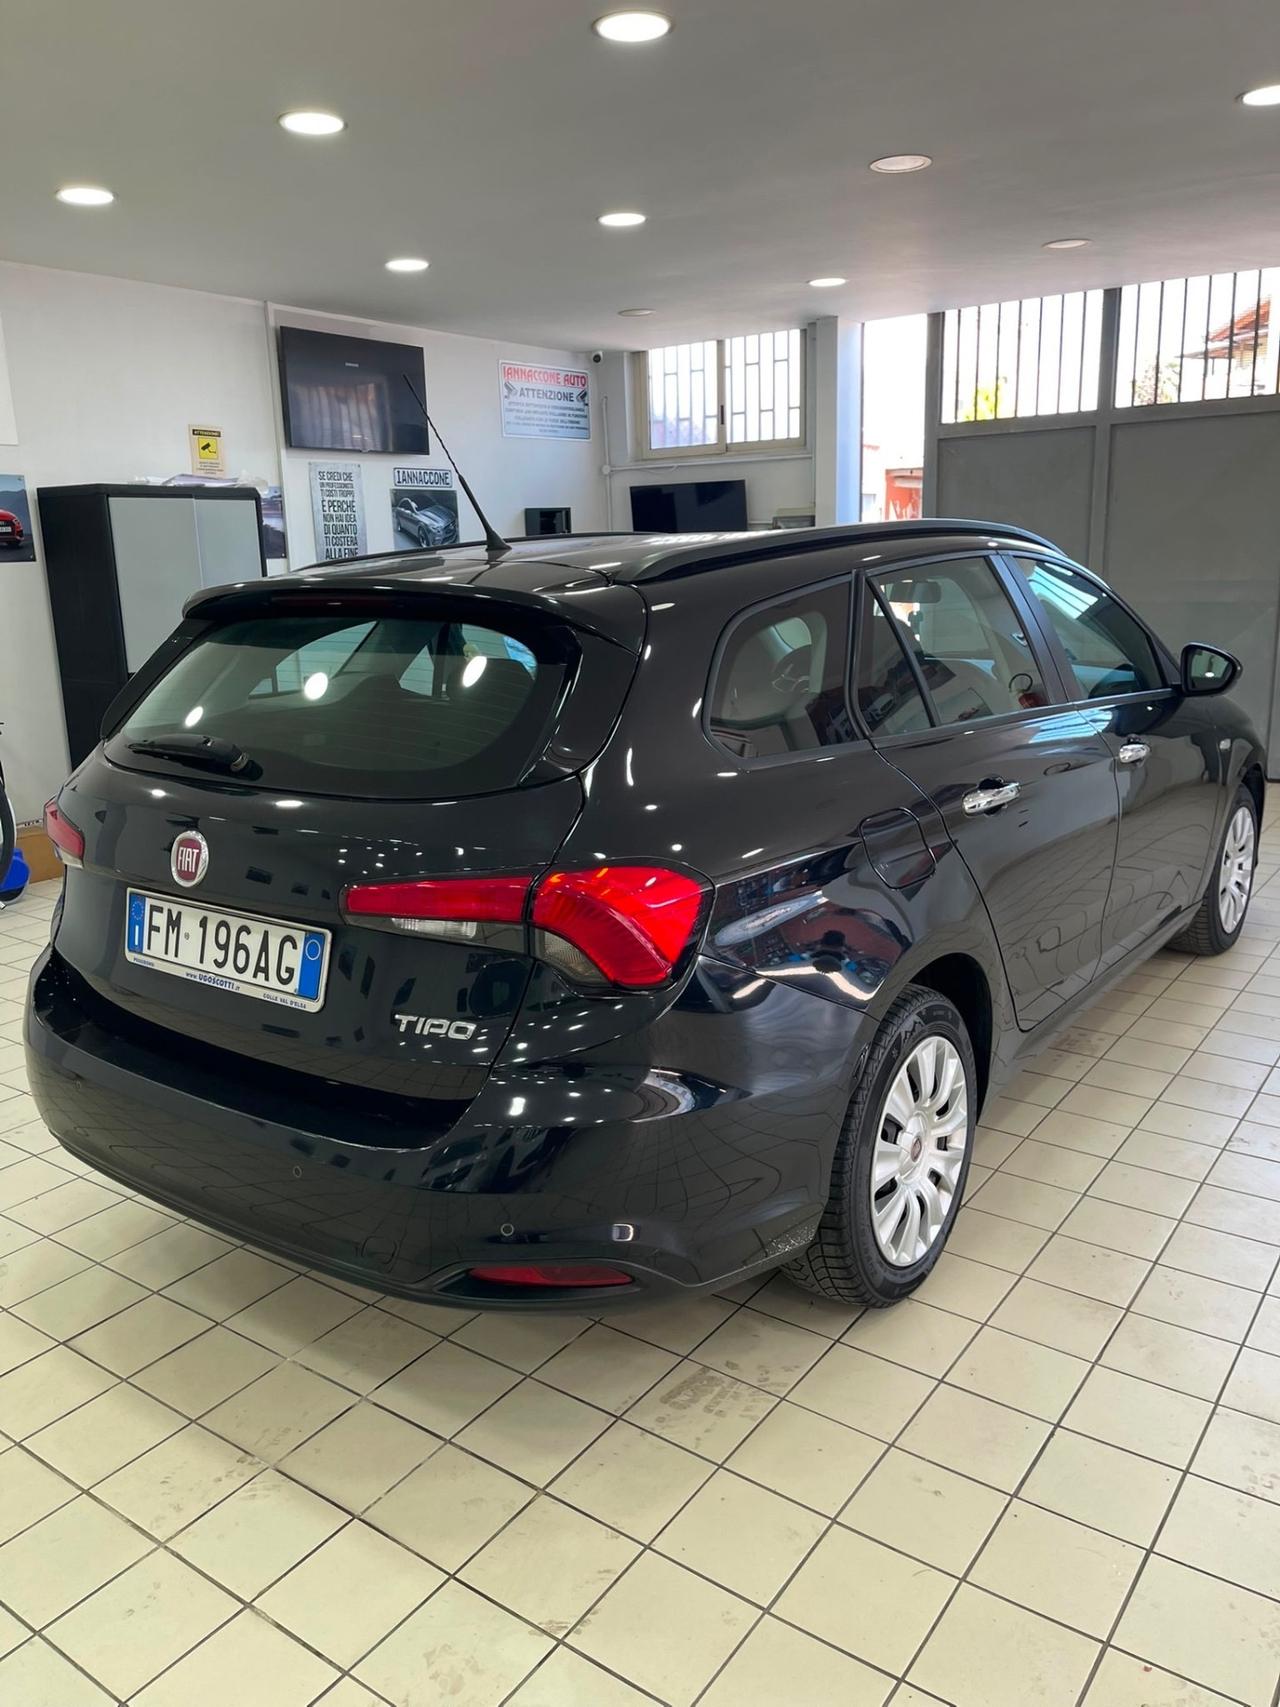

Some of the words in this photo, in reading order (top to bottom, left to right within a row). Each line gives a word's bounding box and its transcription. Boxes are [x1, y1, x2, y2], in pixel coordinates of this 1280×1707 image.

[503, 366, 561, 384] IANNACCONE
[563, 374, 587, 387] AUTO
[520, 387, 574, 402] ATTENZIONE
[319, 471, 326, 481] SE
[326, 471, 342, 481] CREDI
[342, 472, 353, 481] CHE
[396, 470, 450, 485] IANNACCONE
[344, 514, 357, 523] IDEA
[324, 523, 331, 535] DI
[331, 523, 358, 535] QUANTO
[324, 536, 331, 546] TI
[325, 547, 343, 560] ALLA
[177, 846, 200, 873] FIAT
[147, 904, 182, 958] FM
[198, 916, 298, 985] 196AG
[395, 1014, 477, 1040] TIPO
